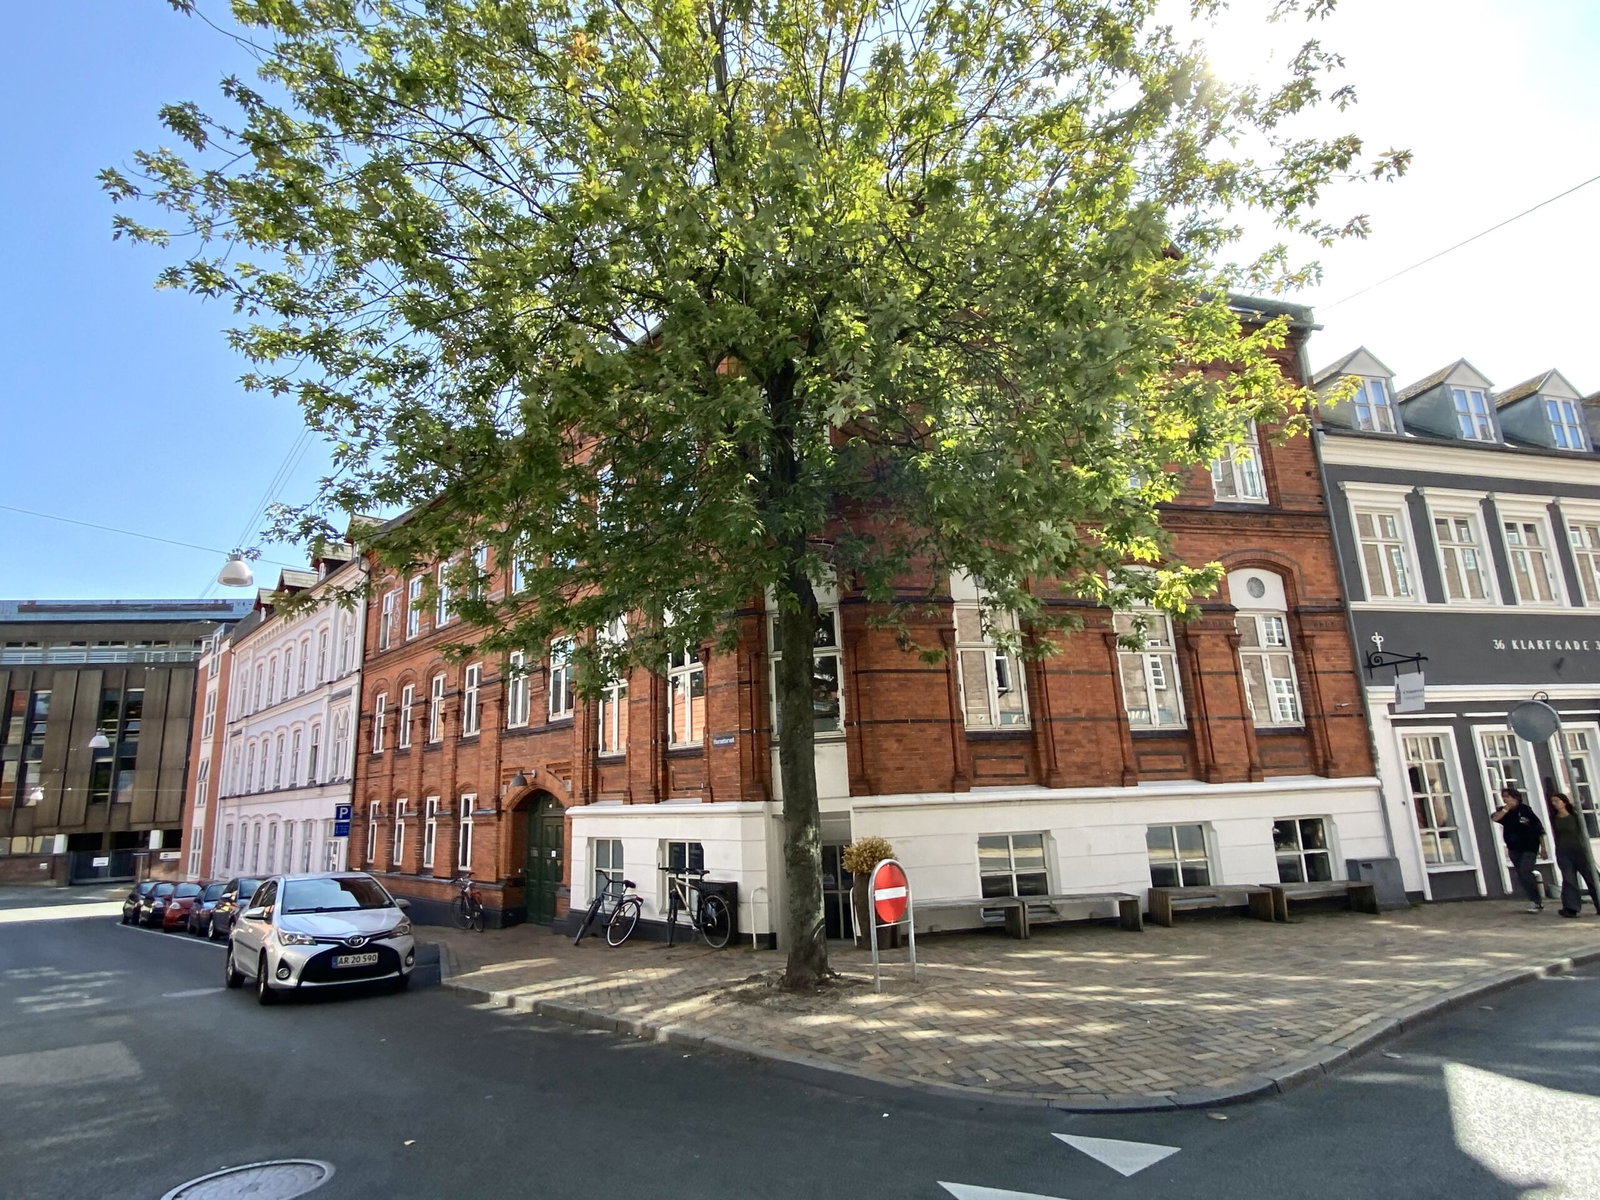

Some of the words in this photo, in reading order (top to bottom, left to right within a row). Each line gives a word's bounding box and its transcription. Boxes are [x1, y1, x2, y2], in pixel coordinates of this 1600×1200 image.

[1493, 640, 1505, 650] 36
[339, 807, 349, 819] P
[362, 954, 376, 962] 590
